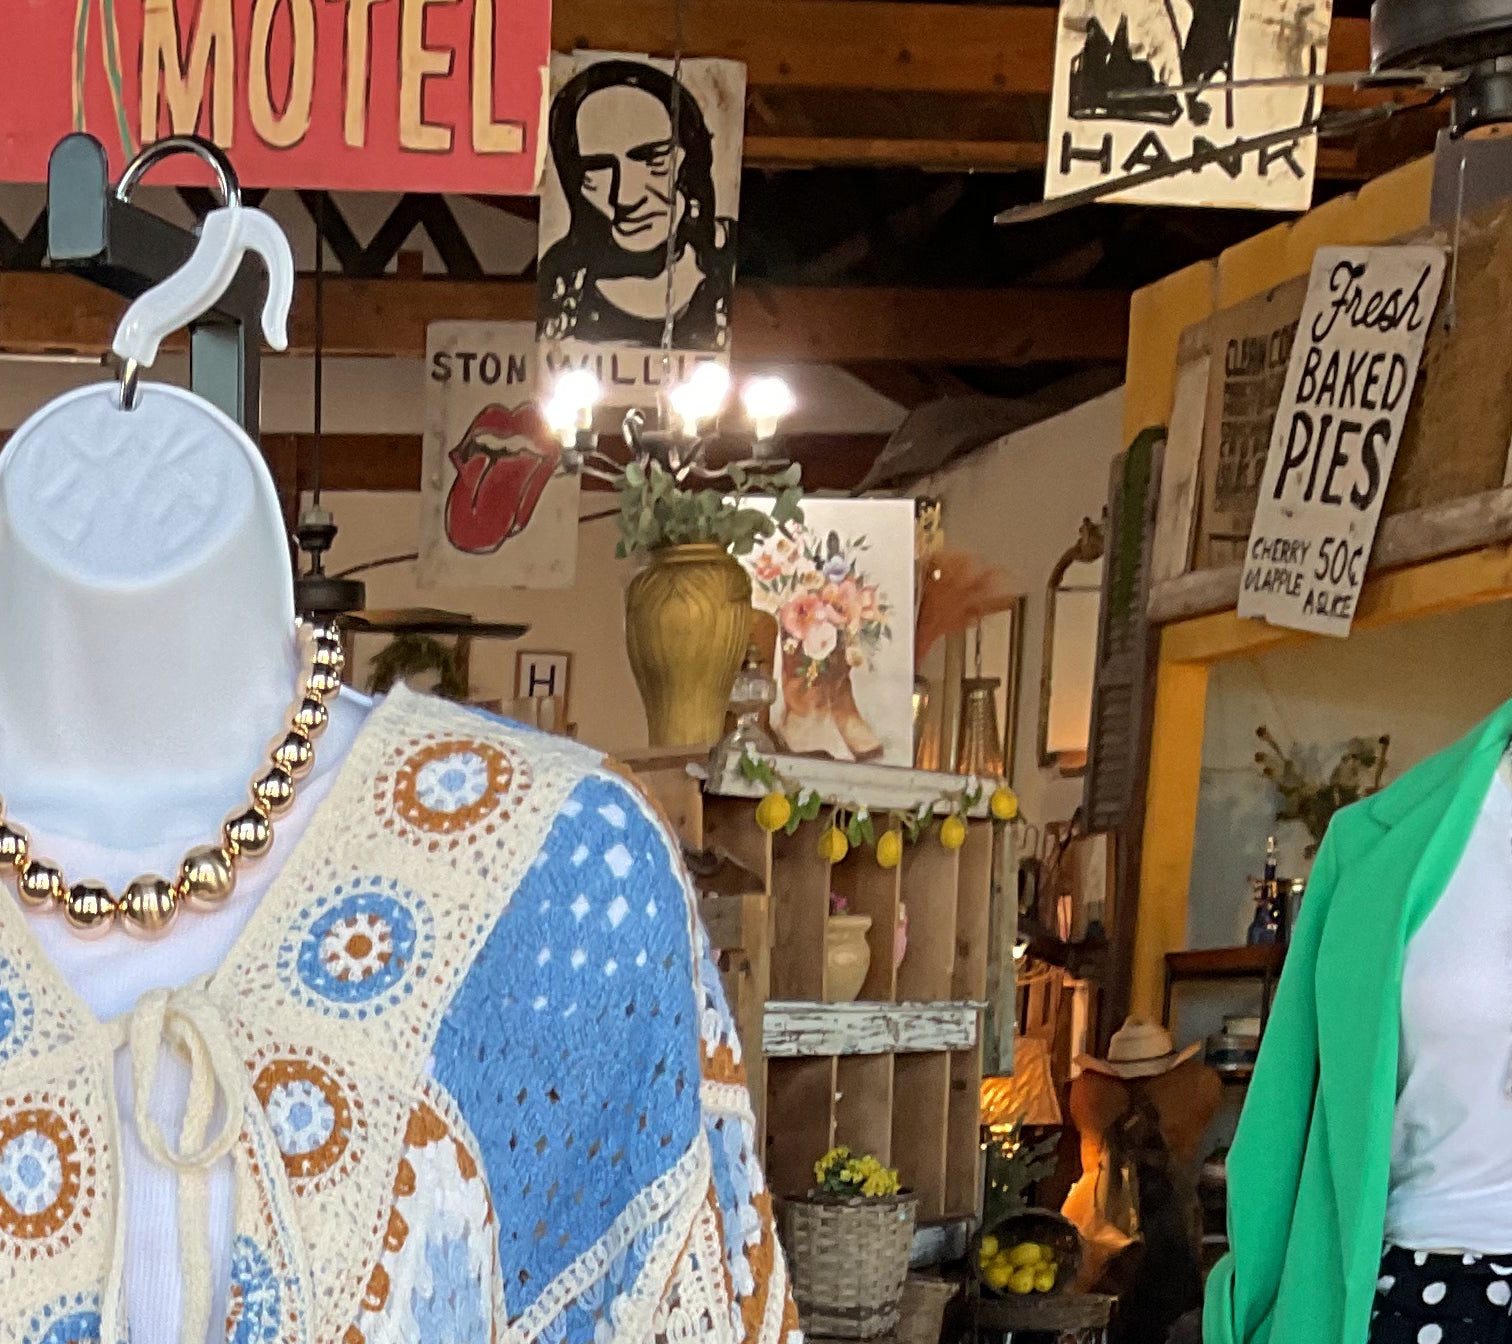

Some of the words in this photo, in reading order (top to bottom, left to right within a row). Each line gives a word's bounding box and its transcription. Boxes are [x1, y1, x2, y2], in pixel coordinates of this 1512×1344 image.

[140, 0, 526, 154] MOTEL
[1059, 130, 1305, 179] HANK
[1311, 260, 1432, 343] Fresh
[430, 351, 528, 386] STON
[1295, 346, 1408, 412] BAKED
[1272, 410, 1392, 512] PIES
[1251, 536, 1312, 566] CHERRY
[529, 663, 556, 697] H
